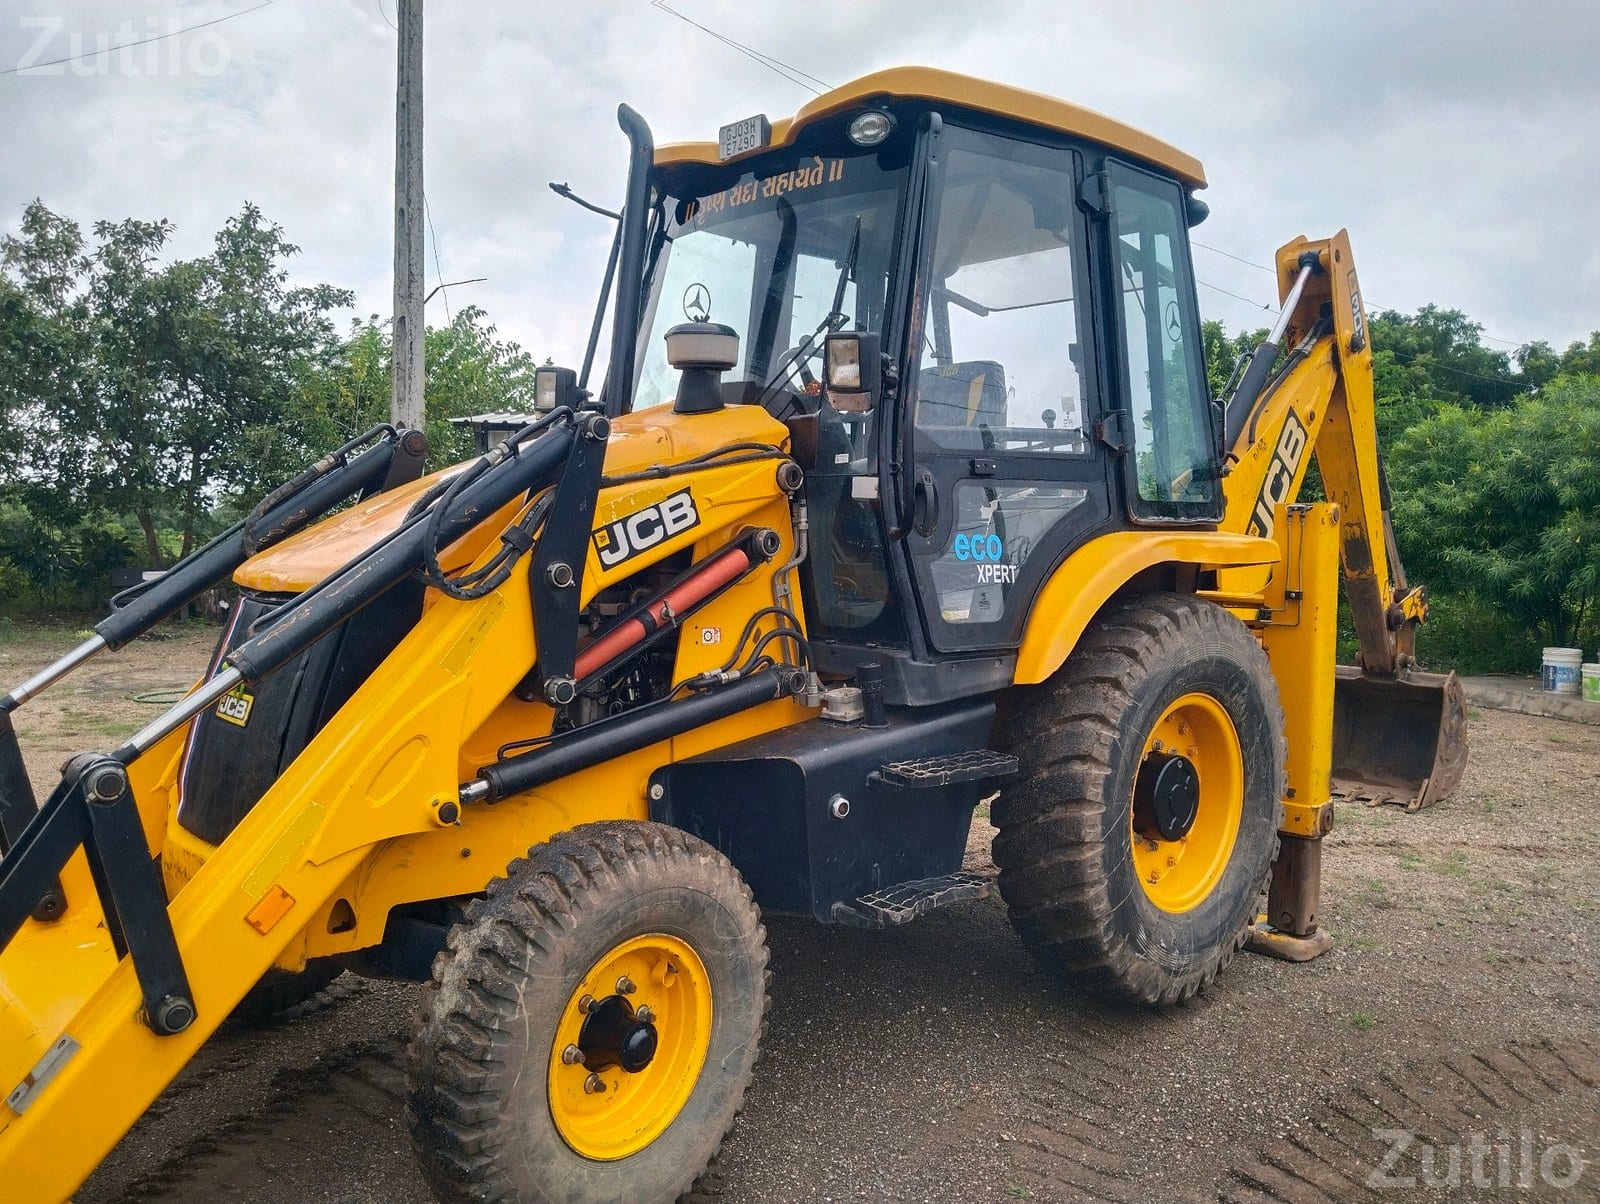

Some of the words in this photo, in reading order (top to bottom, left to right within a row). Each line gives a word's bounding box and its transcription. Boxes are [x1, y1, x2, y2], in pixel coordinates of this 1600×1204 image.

[726, 119, 756, 141] GJ03H
[726, 134, 755, 156] E7490
[600, 492, 697, 565] JCB
[953, 533, 1003, 561] eco
[976, 564, 1017, 585] XPERT
[219, 694, 248, 719] JCB
